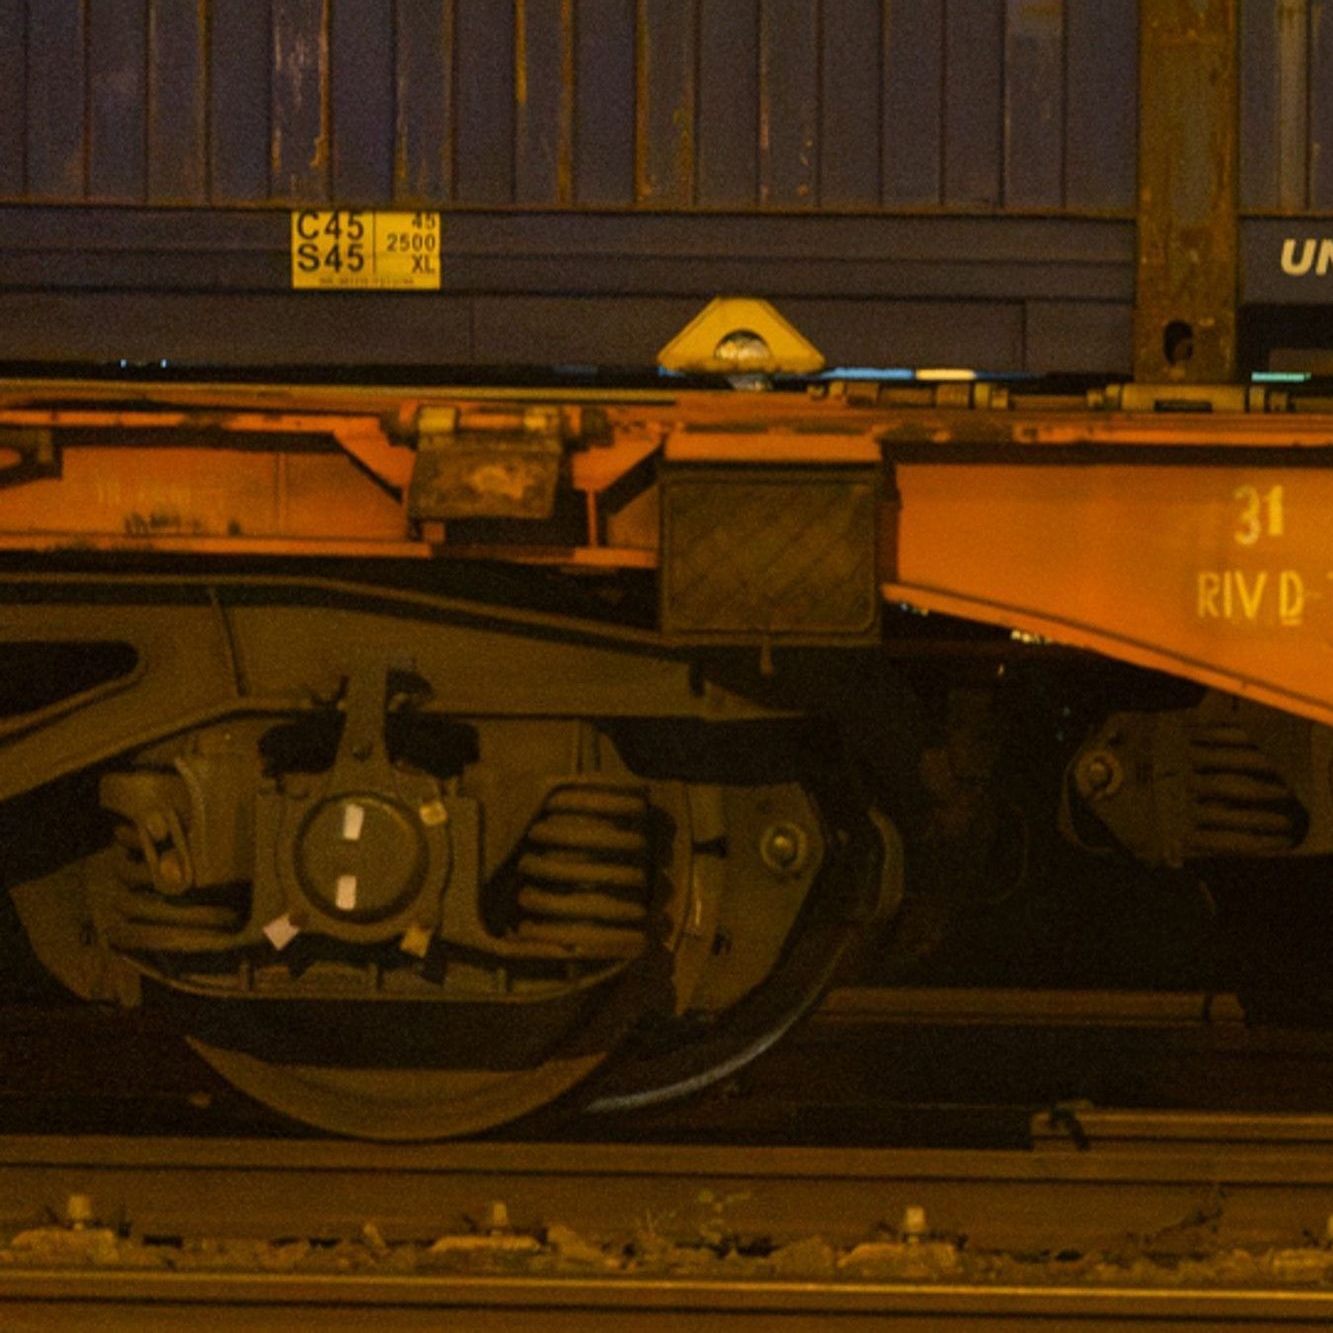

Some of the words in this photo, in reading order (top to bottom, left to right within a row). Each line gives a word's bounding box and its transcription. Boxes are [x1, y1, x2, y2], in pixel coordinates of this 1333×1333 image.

[296, 211, 365, 241] C45
[387, 233, 436, 252] 2500
[297, 243, 365, 272] S45
[411, 254, 436, 274] XL
[1233, 484, 1284, 546] 31
